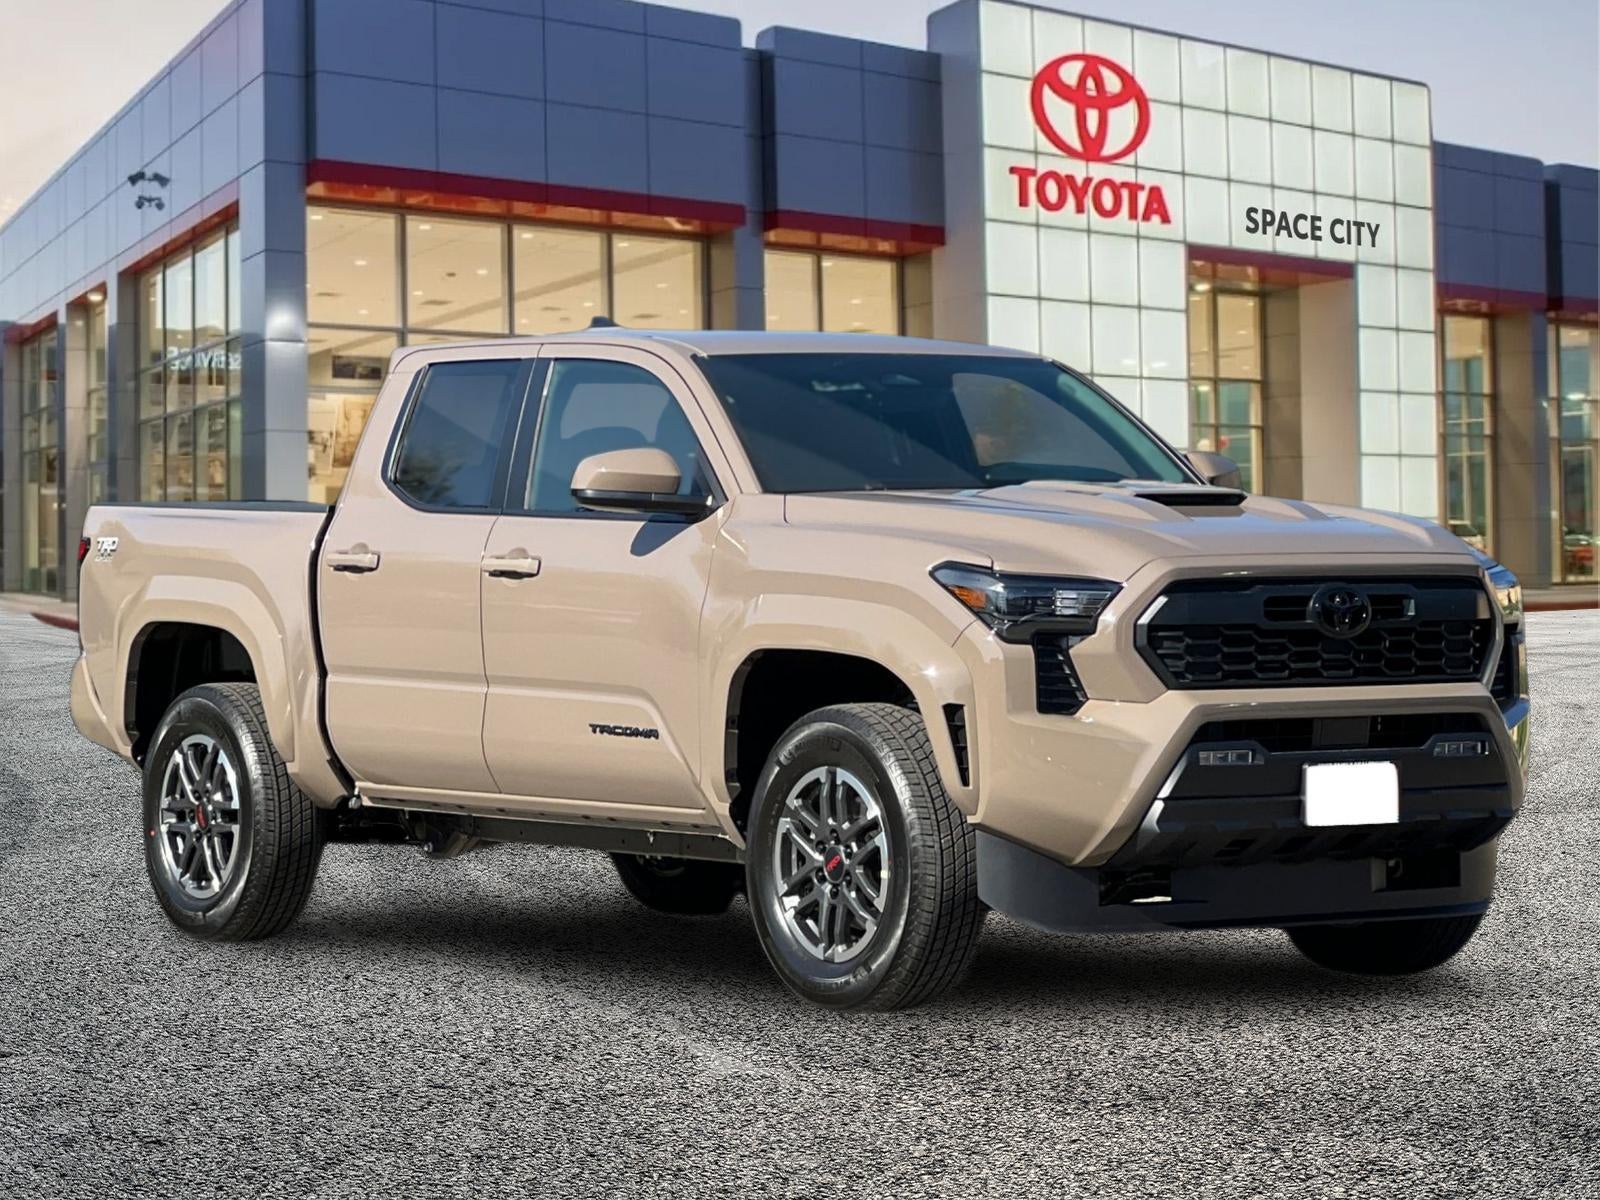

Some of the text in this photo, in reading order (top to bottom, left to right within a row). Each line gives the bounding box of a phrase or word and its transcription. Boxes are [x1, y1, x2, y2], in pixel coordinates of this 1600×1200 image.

[1009, 166, 1171, 225] TOYOTA
[1245, 206, 1381, 248] SPACE CITY
[97, 536, 119, 554] TRD
[588, 723, 660, 740] TACOMA
